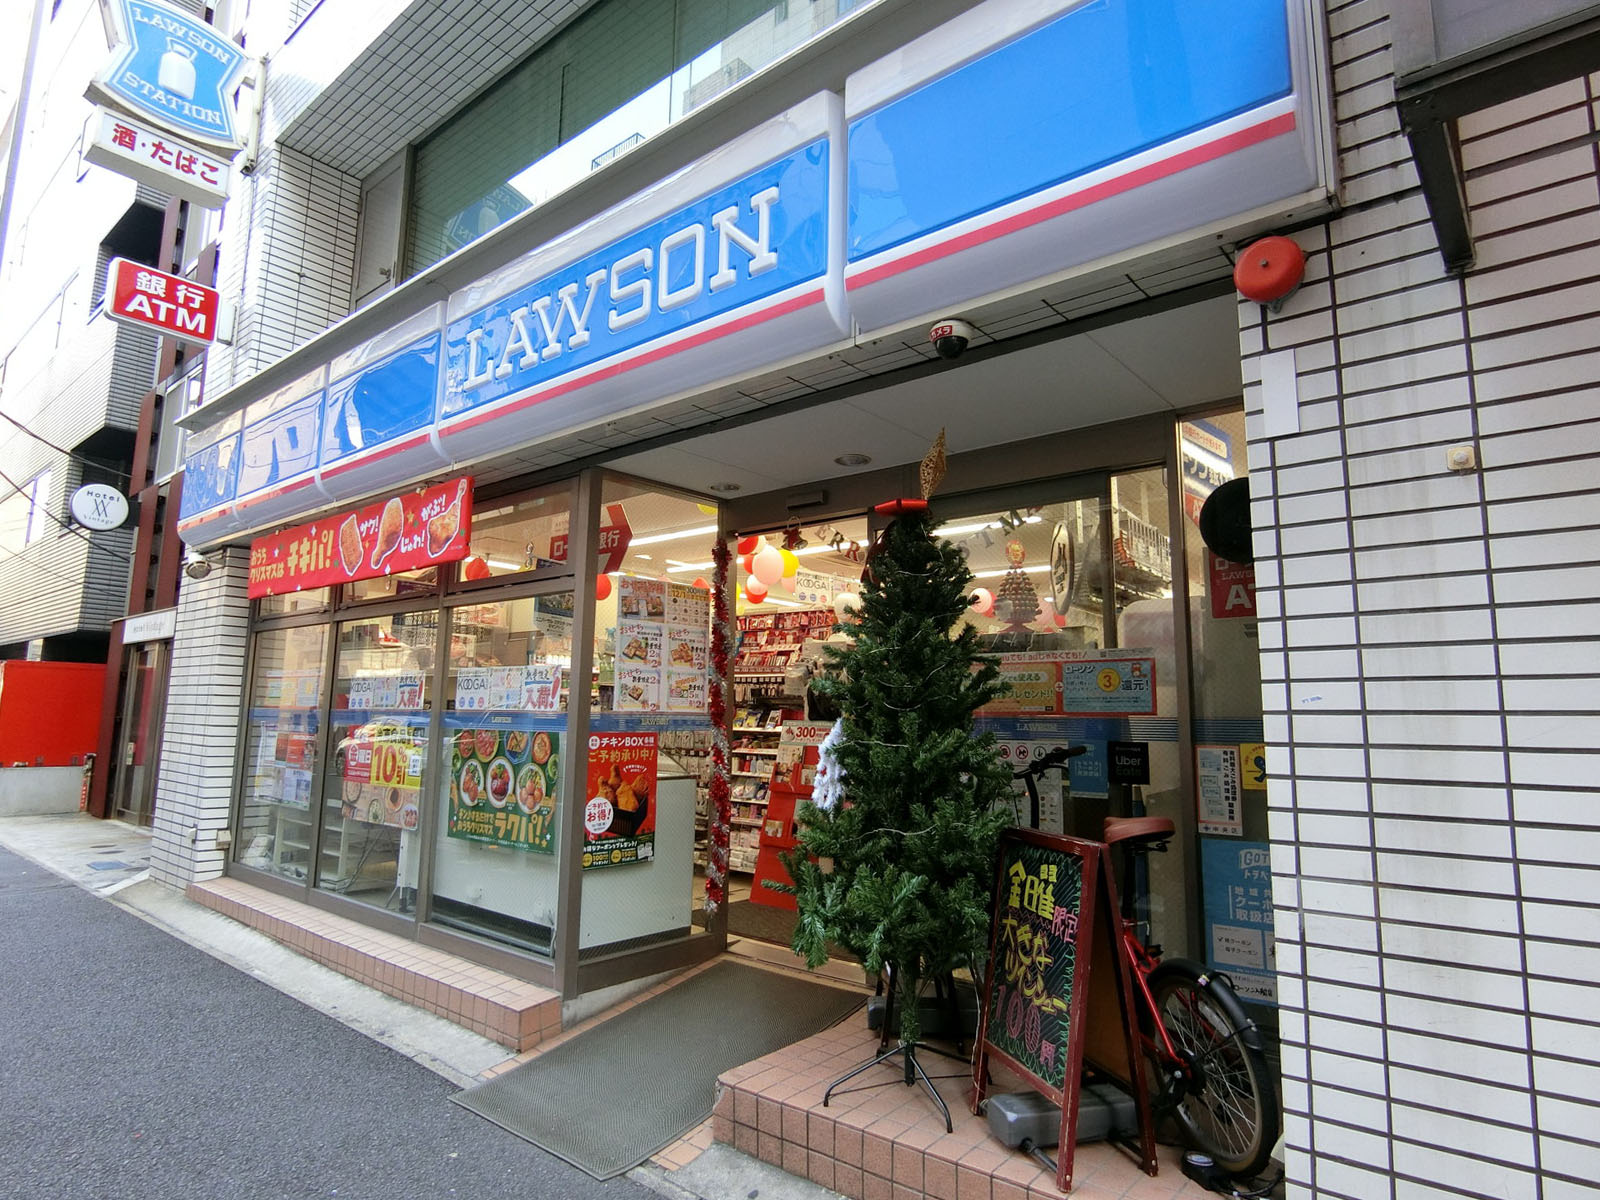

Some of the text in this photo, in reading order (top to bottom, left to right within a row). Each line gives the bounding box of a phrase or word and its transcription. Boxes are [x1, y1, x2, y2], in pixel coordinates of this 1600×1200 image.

[133, 7, 232, 65] LAWSON
[123, 72, 223, 125] STATION
[112, 123, 219, 186] 酒・たばこ
[136, 271, 205, 309] 銀行
[463, 186, 780, 392] LAWSON
[125, 295, 206, 335] ATM
[87, 491, 119, 502] Hotel
[251, 548, 267, 566] おうち
[287, 529, 334, 577] チキパ!
[250, 562, 285, 583] クリスマスは
[1121, 679, 1149, 691] 還元!
[588, 748, 654, 763] ご予約承り中!
[601, 737, 644, 747] チキンBOX
[1115, 755, 1142, 766] Uber
[494, 811, 543, 845] ラクパ!
[587, 809, 612, 823] お得!
[1008, 859, 1079, 943] 金曜 限定
[1002, 913, 1054, 973] 大きな
